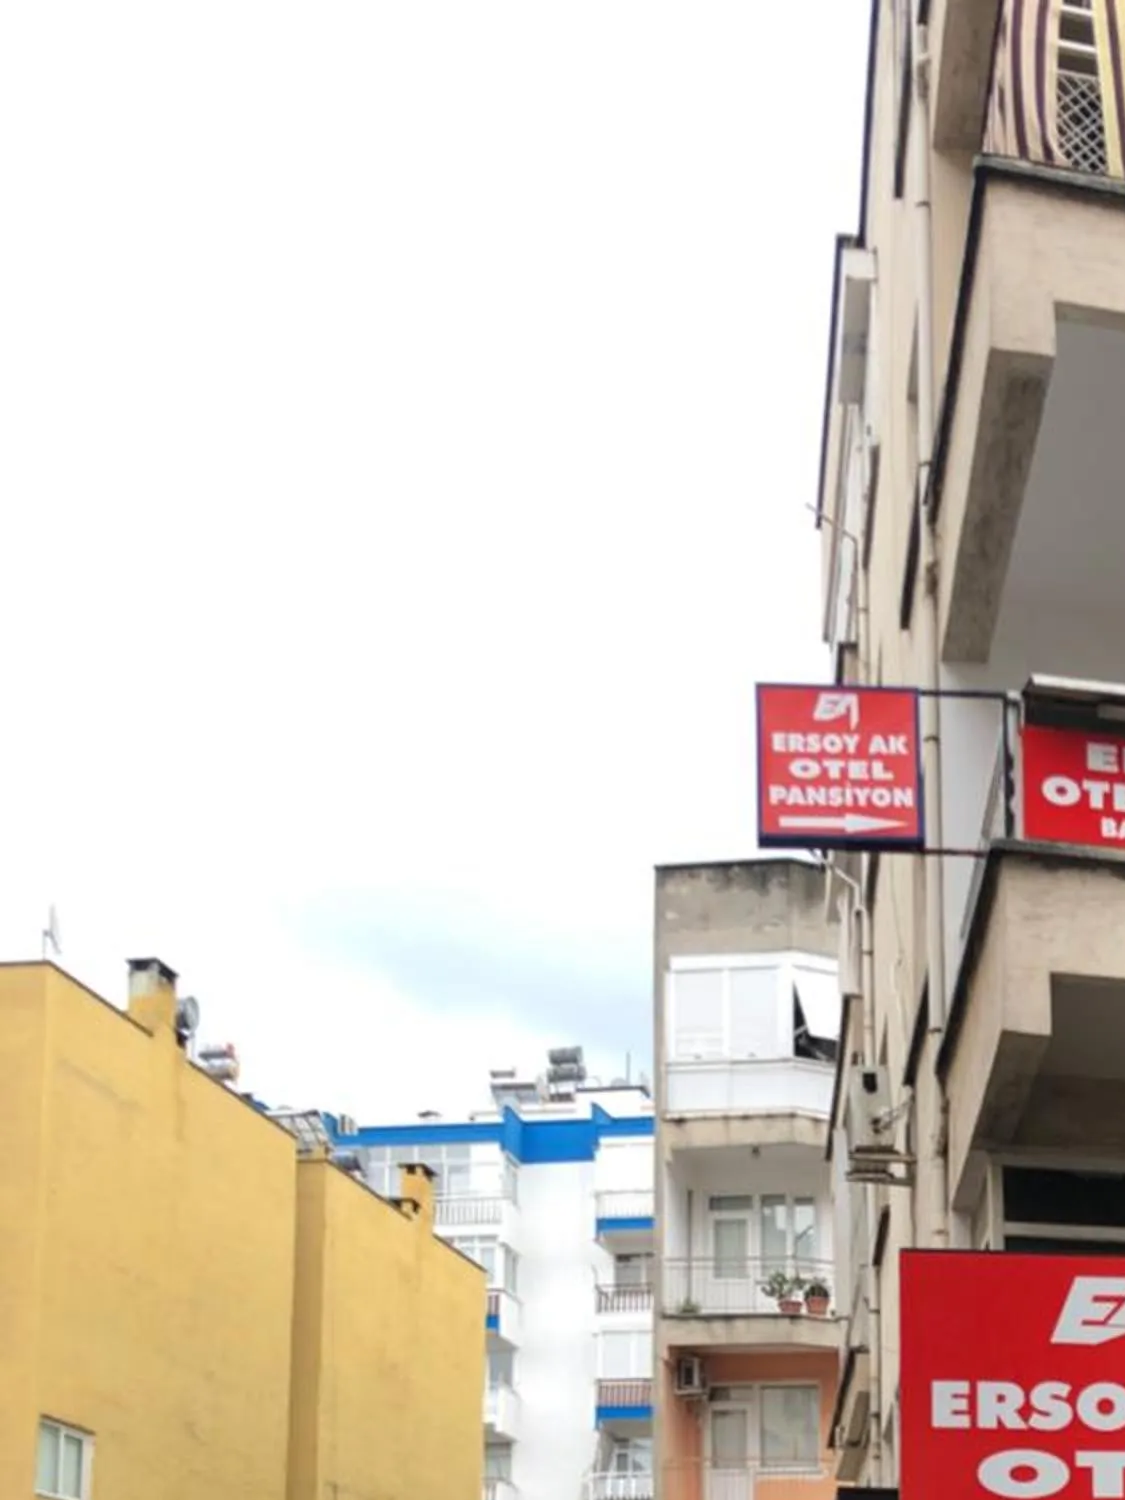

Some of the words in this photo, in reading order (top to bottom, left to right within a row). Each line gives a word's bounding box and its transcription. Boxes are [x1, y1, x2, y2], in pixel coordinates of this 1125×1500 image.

[771, 732, 860, 754] ERSOY
[869, 734, 909, 755] AK
[788, 757, 894, 780] OTEL
[768, 782, 914, 807] PANSİYON
